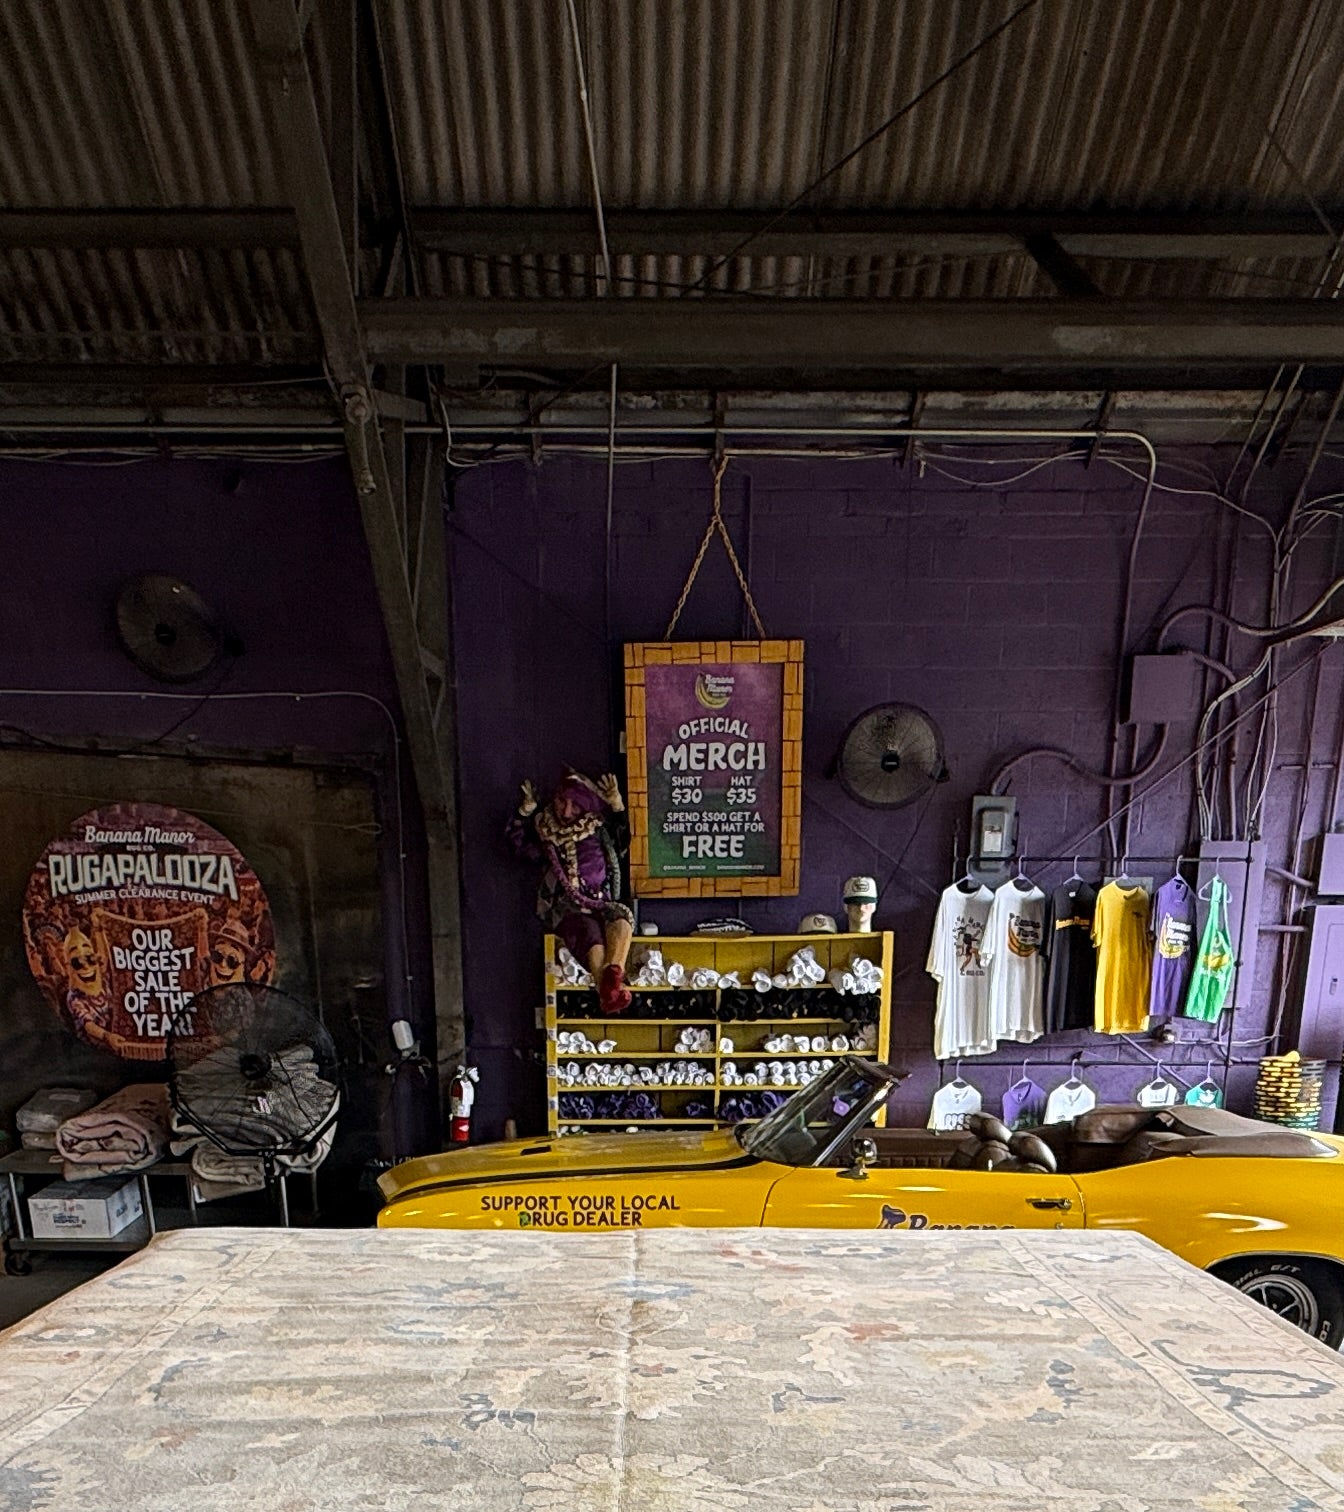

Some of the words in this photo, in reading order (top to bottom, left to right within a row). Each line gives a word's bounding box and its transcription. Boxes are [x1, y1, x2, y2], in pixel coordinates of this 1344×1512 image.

[678, 717, 748, 740] OFFICIAL
[662, 742, 766, 771] MERCH
[671, 776, 702, 786] SHIRT
[731, 776, 753, 786] HAT
[671, 788, 702, 805] $30
[726, 788, 757, 805] $35
[667, 812, 700, 822] SPEND
[702, 812, 727, 822] $500
[729, 812, 753, 822] GET
[753, 812, 761, 822] A
[85, 826, 141, 844] Banana
[143, 827, 196, 844] Manor
[663, 822, 692, 833] SHIRT
[695, 822, 709, 833] OR
[712, 822, 719, 833] A
[721, 822, 742, 833] HAT
[744, 822, 765, 833] FOR
[682, 835, 745, 858] FREE
[49, 853, 239, 901] RUGAPALOOZA
[75, 890, 116, 905] SUMMER
[118, 888, 179, 900] CLEARANCE
[181, 891, 216, 905] EVENT
[132, 929, 173, 950] OUR
[112, 947, 195, 971] BIGGEST
[135, 972, 180, 991] SALE
[124, 993, 152, 1013] OF
[155, 992, 198, 1013] THE
[481, 1196, 562, 1211] SUPPORT
[567, 1196, 616, 1210] YOUR
[621, 1195, 681, 1210] LOCAL
[519, 1211, 568, 1227] DRUG
[573, 1211, 642, 1226] DEALER
